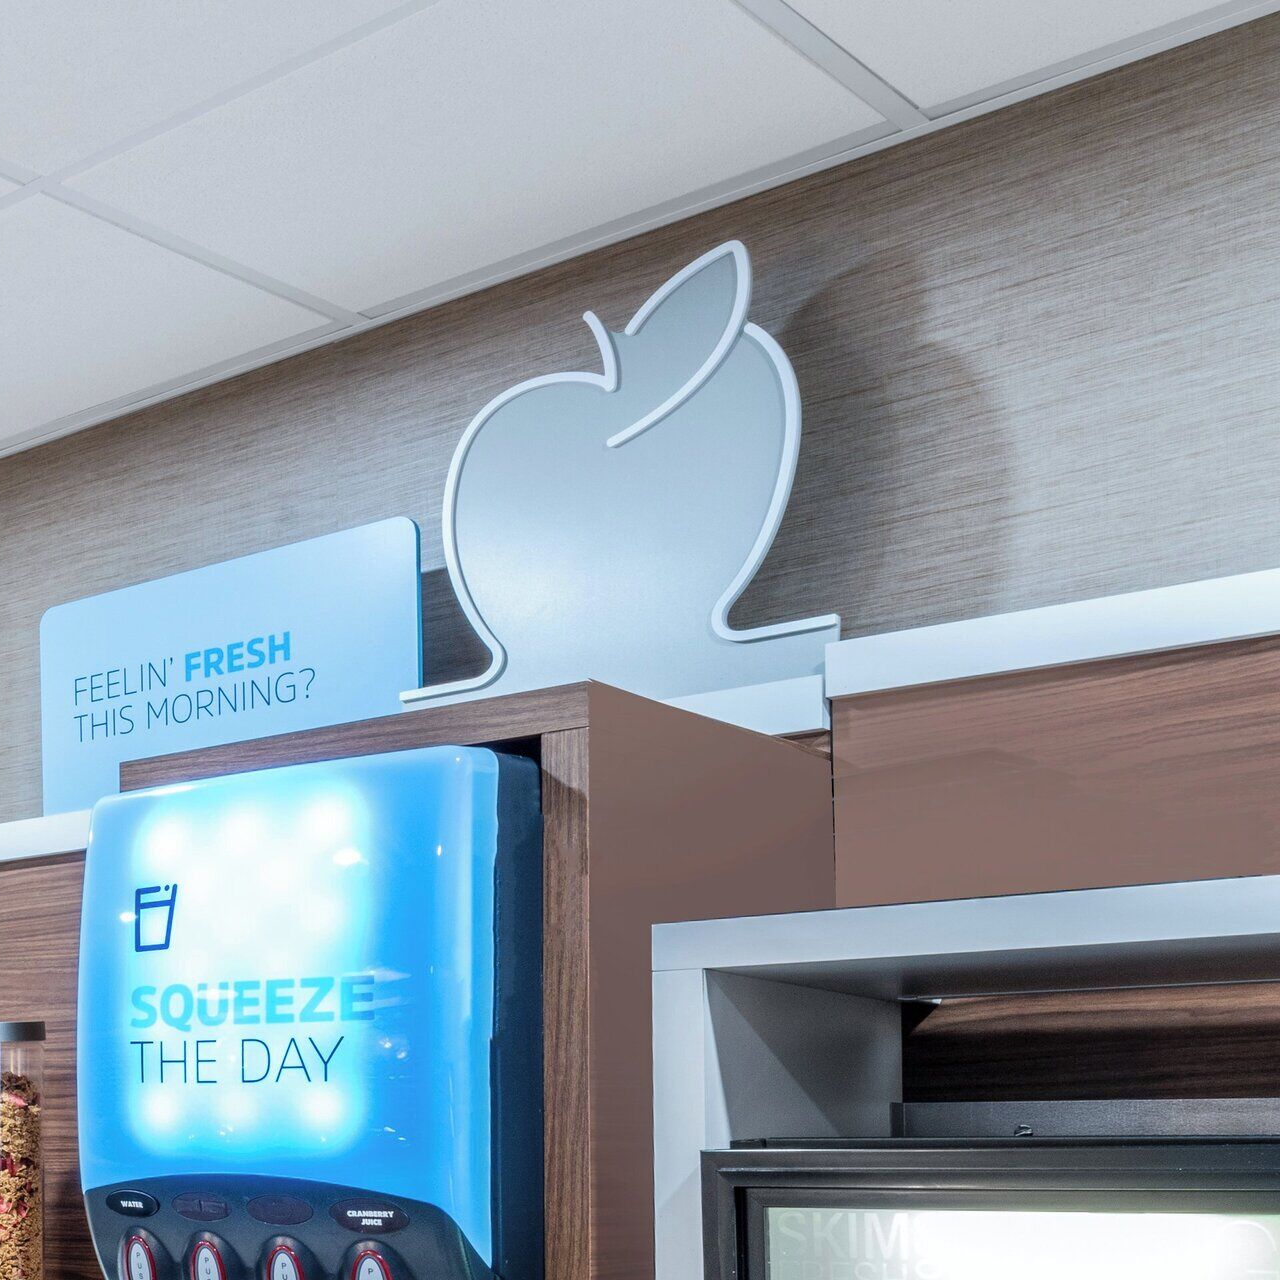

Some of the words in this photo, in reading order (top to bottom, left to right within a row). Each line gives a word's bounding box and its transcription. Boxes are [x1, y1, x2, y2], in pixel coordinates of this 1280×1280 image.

[185, 631, 291, 682] FRESH
[73, 705, 135, 743] THIS
[147, 667, 316, 730] MORNING?
[130, 975, 376, 1033] SQUEEZE
[130, 1039, 218, 1084] THE
[241, 1035, 345, 1083] DAY
[120, 1200, 144, 1209] WATER
[346, 1209, 395, 1218] CRANBERRY
[361, 1218, 383, 1226] JUICE
